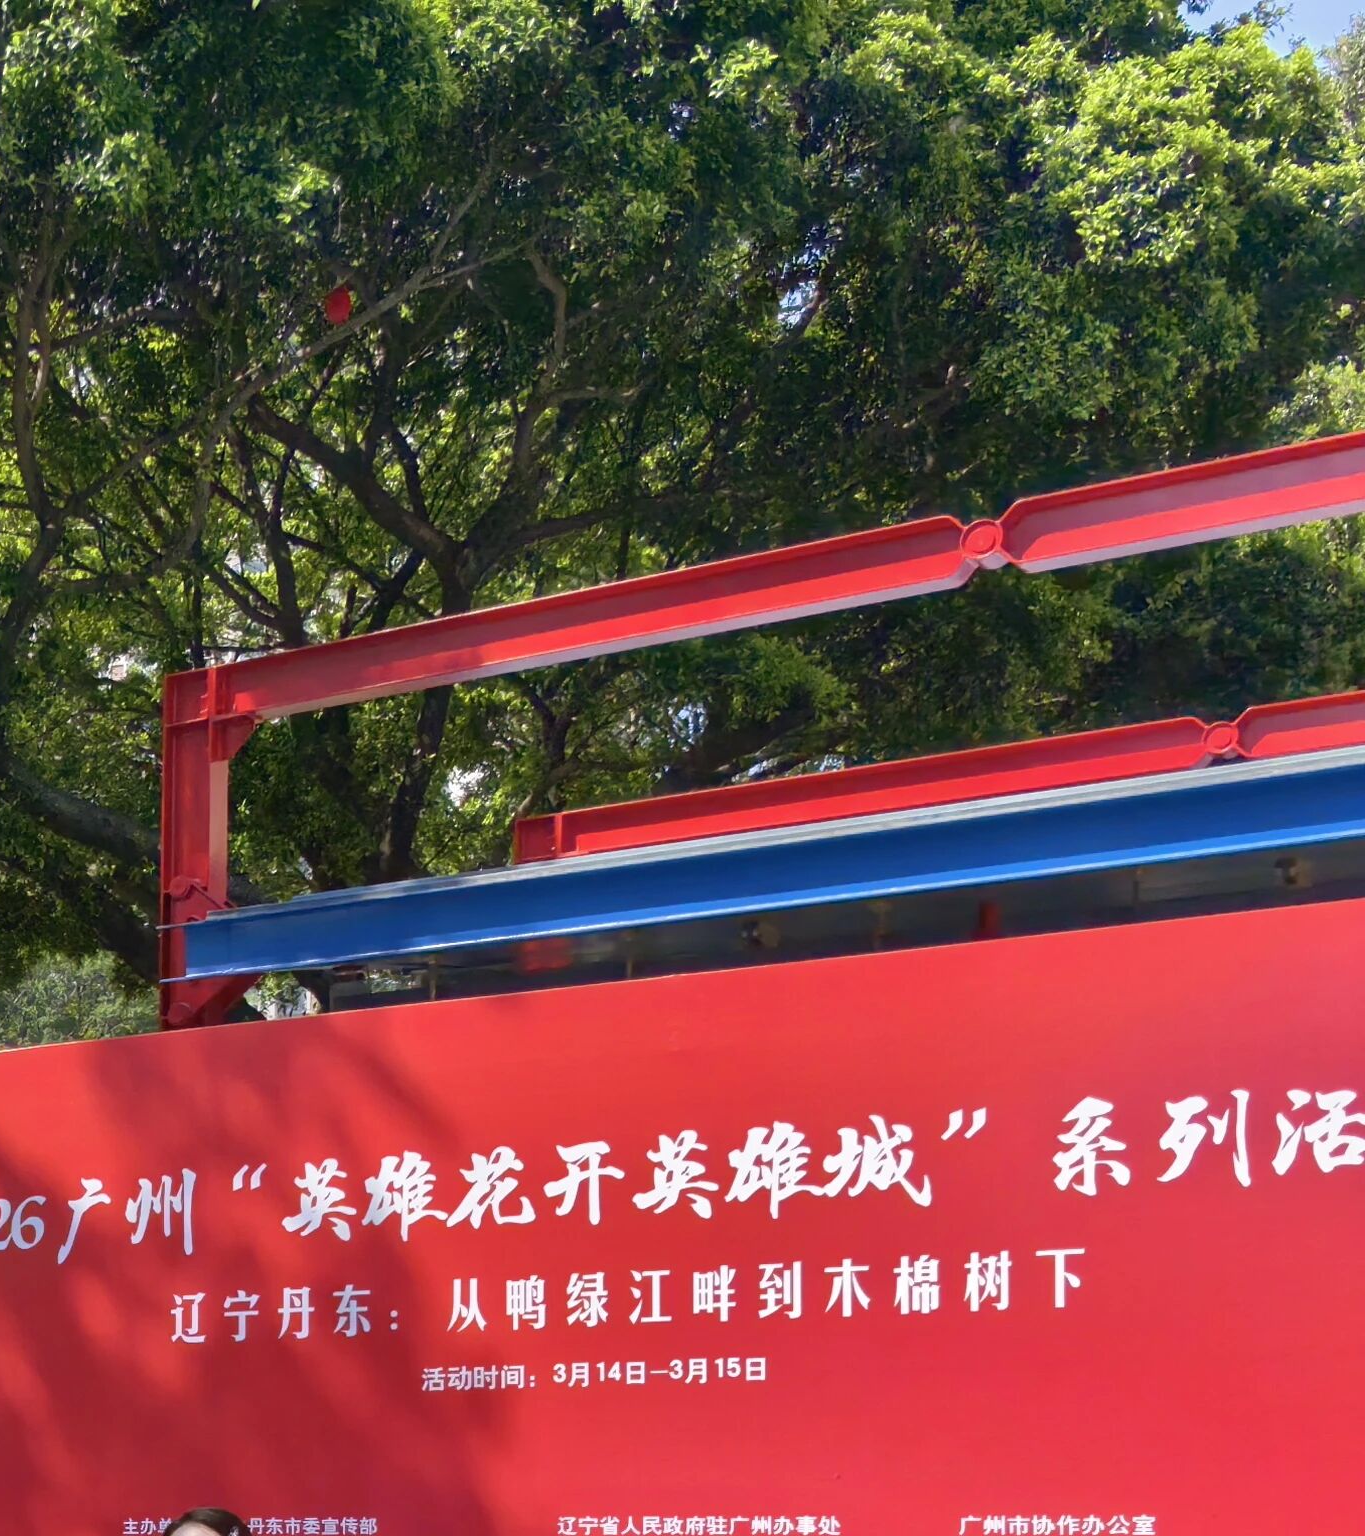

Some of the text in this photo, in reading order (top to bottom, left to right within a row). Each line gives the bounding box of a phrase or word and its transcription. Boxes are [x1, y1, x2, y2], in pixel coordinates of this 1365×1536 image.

[247, 1517, 378, 1536] 丹东市委宣传部
[557, 1516, 841, 1536] 辽宁省人民政府驻广州办事处
[958, 1514, 1157, 1536] 广州市协作办公室
